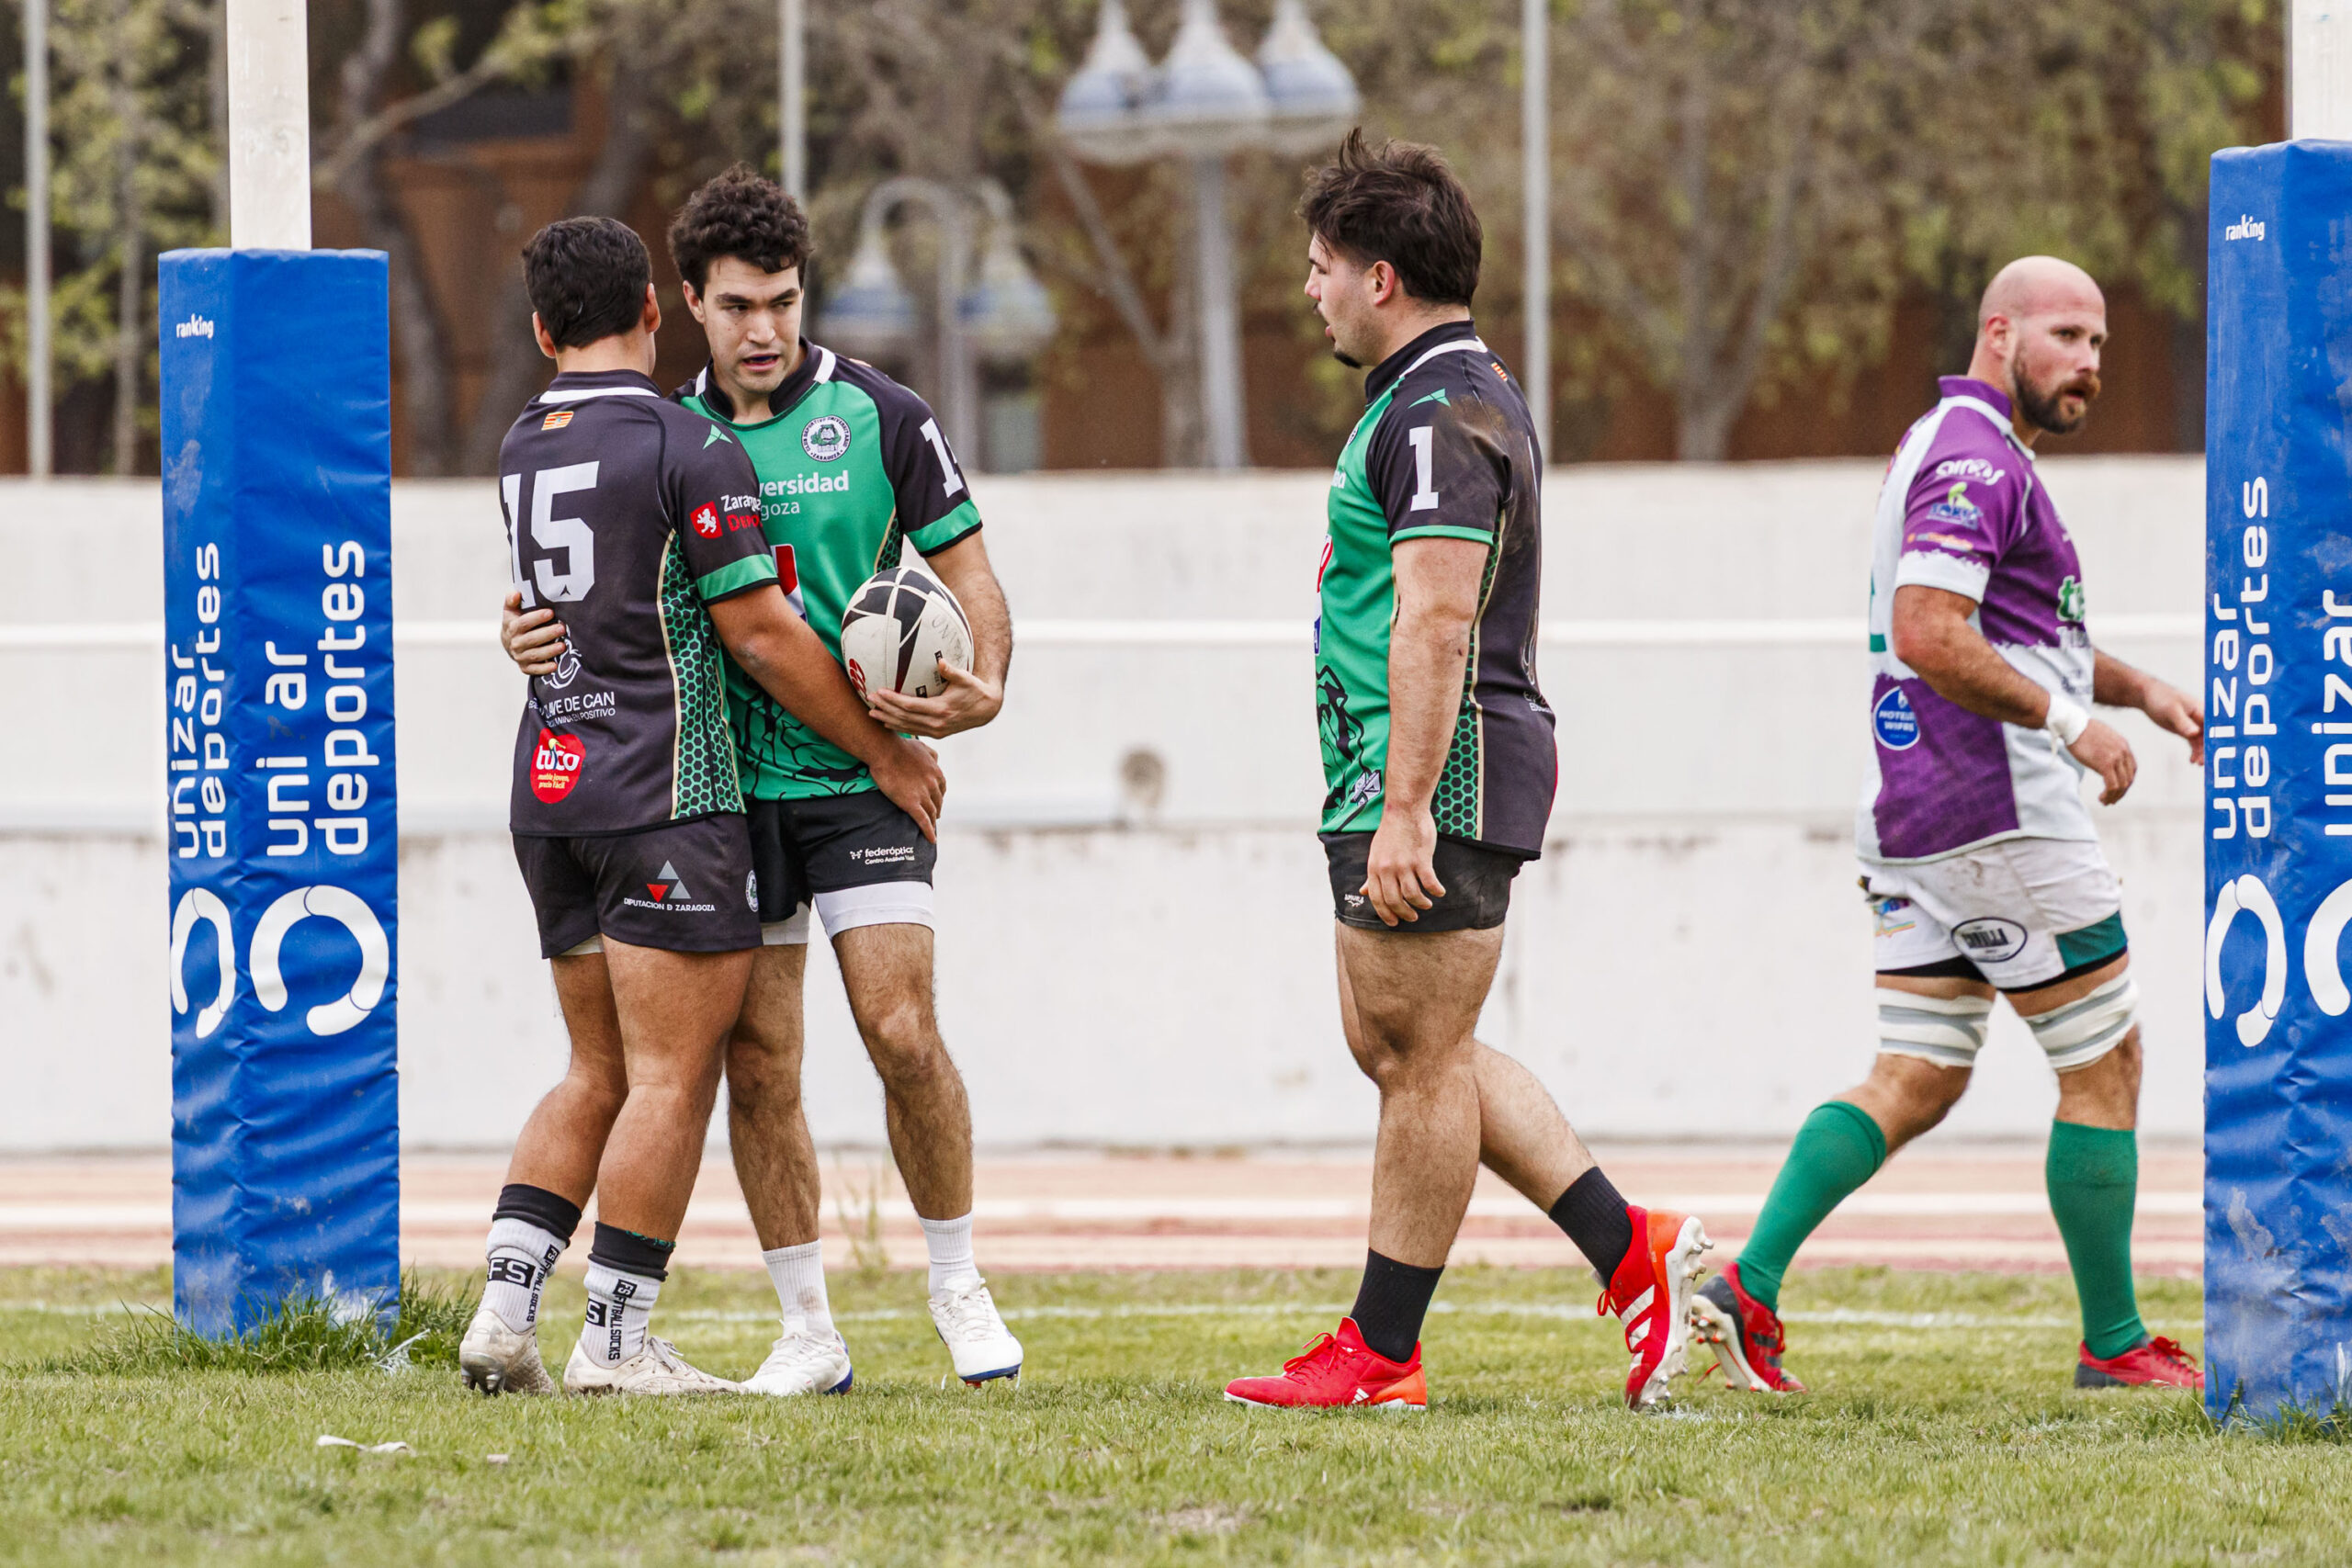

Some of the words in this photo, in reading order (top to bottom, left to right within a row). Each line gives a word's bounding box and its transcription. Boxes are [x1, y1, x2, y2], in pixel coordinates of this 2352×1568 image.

[2225, 214, 2266, 242] ranking
[175, 313, 214, 339] ranking
[759, 469, 849, 497] versidad
[1408, 426, 1440, 512] 1
[761, 502, 800, 521] goza
[503, 460, 600, 610] 15
[2238, 476, 2277, 839] deportes
[195, 542, 230, 859] deportes
[313, 540, 379, 855] deportes
[564, 695, 581, 712] DE
[582, 692, 616, 709] CAN
[581, 707, 616, 721] POSITIVO
[2209, 592, 2239, 840] unizar
[171, 643, 200, 859] unizar
[536, 745, 581, 772] tuco
[623, 897, 665, 910] DIPUTACION
[675, 904, 716, 912] ZARAGOZA
[490, 1258, 529, 1284] FS
[617, 1281, 635, 1296] FS
[526, 1292, 539, 1322] SOCKS
[608, 1329, 622, 1360] SOCKS
